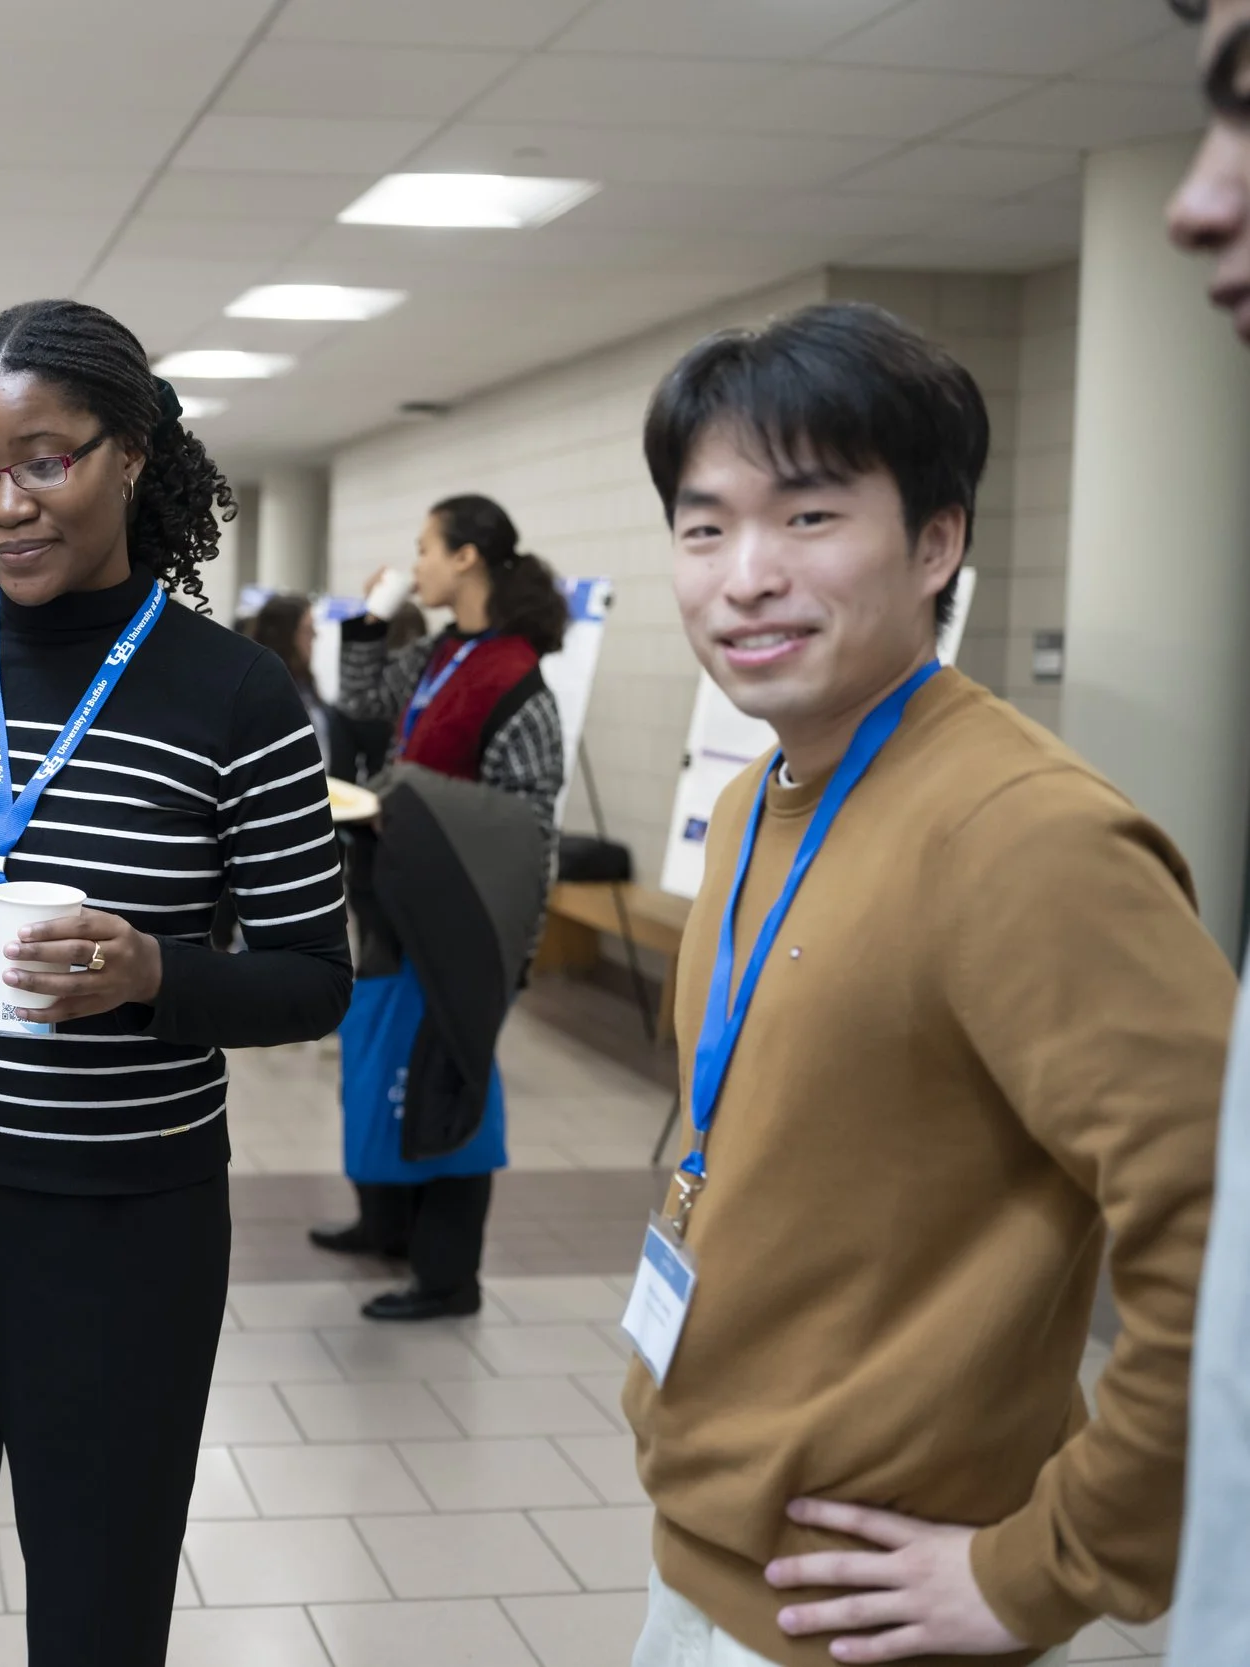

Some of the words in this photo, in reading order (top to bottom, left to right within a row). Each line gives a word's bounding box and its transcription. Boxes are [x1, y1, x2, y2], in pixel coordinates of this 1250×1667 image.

[105, 641, 135, 665] UB
[127, 608, 154, 641] University
[151, 601, 157, 611] at
[86, 679, 108, 707] Buffalo
[82, 706, 91, 716] at
[57, 714, 87, 755] University
[32, 755, 64, 780] UB
